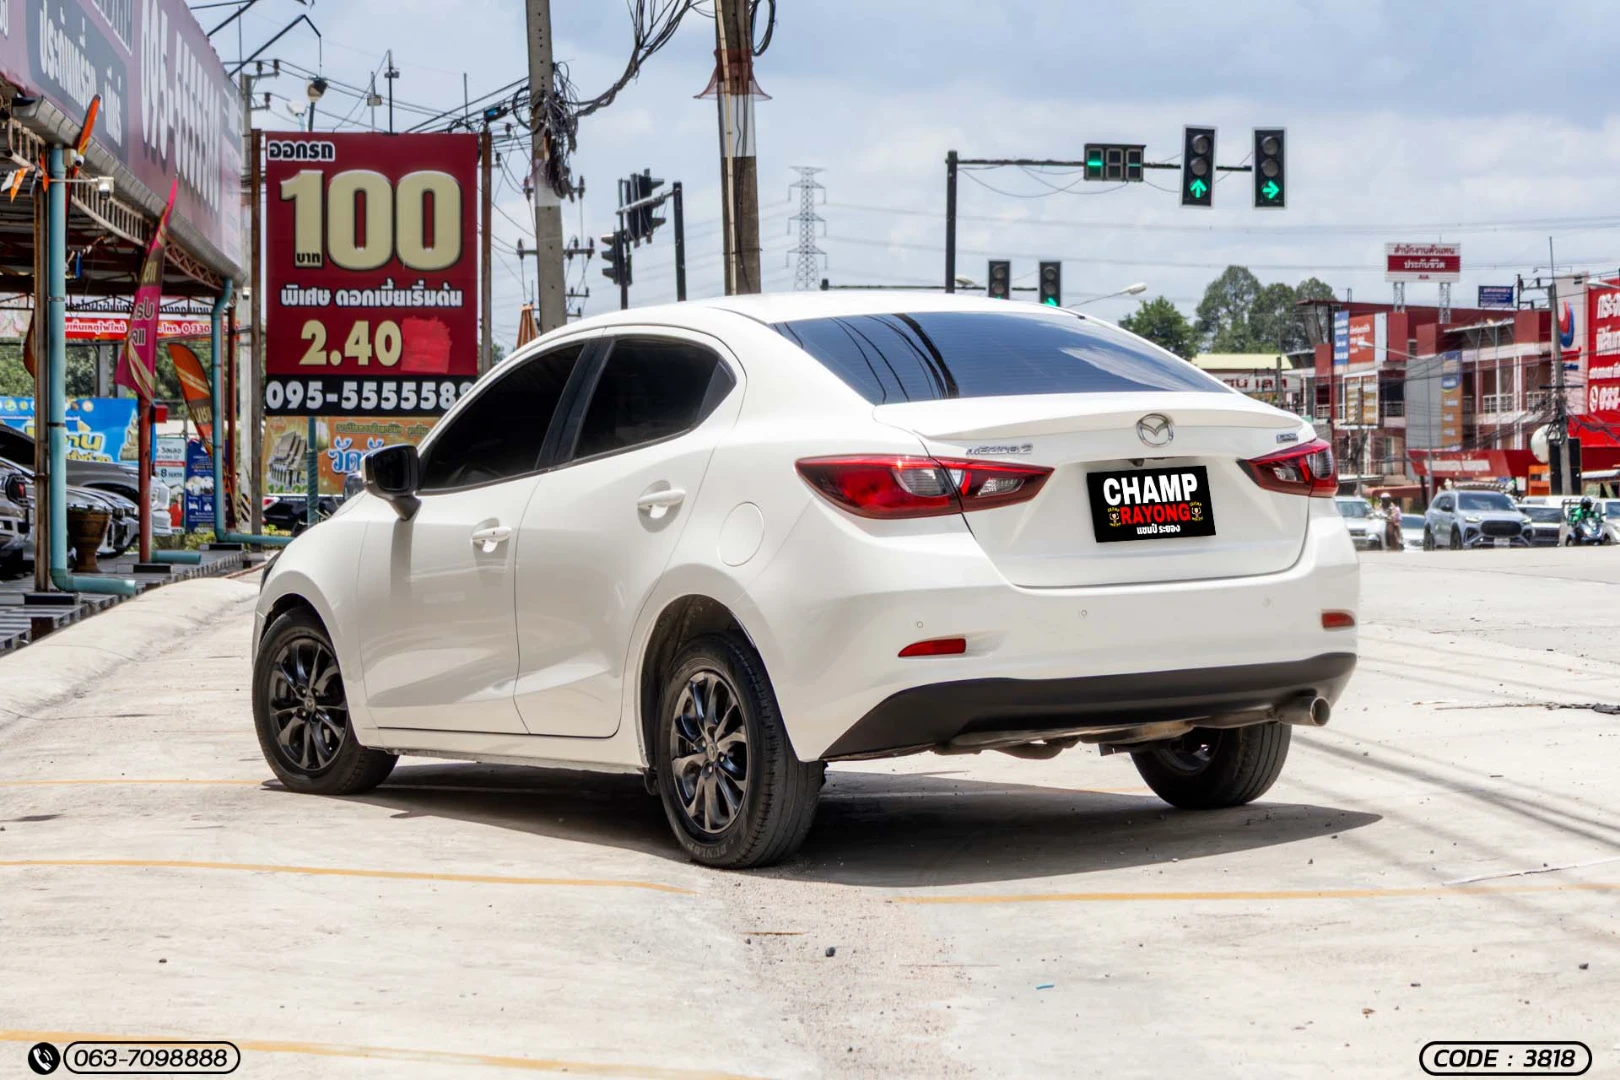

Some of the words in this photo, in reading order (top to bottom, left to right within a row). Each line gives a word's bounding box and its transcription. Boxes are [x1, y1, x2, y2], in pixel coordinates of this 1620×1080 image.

[141, 0, 220, 213] 095-5555588
[268, 142, 335, 161] ออกรถ
[280, 169, 461, 270] 100
[296, 252, 320, 263] บาท
[1394, 243, 1455, 255] สำนักงานตัวแทน
[1404, 259, 1446, 269] ประกันชีวิต
[281, 284, 331, 306] พิเศษ
[335, 277, 463, 306] ดอกเบี้ยเริ่มต้น
[299, 319, 402, 367] 2.40
